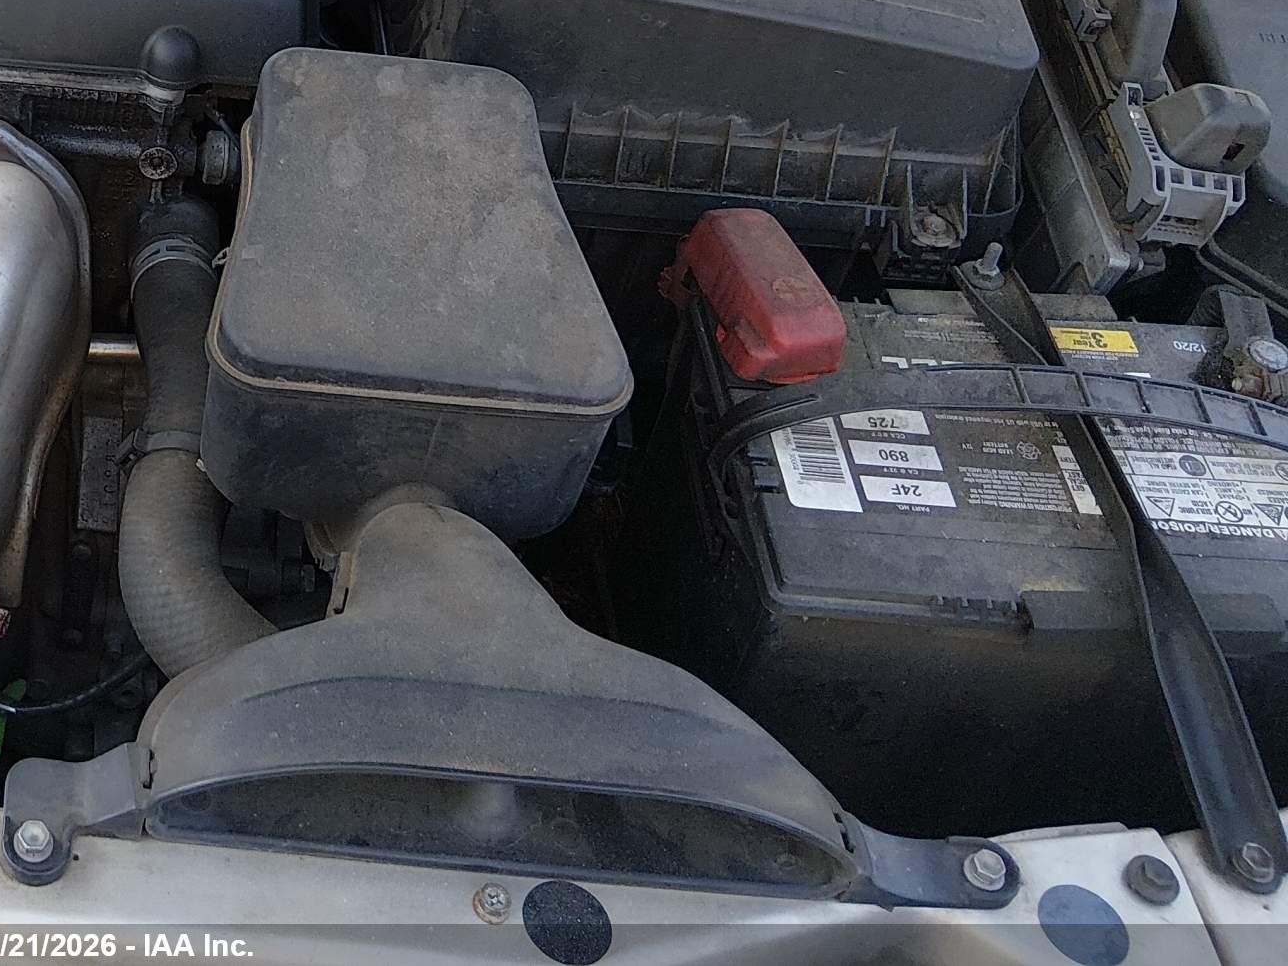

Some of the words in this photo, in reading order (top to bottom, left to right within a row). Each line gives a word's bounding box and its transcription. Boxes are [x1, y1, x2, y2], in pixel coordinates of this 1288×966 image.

[1173, 340, 1208, 354] 12/20
[867, 417, 900, 430] 725
[878, 449, 910, 463] 890
[891, 483, 922, 497] 24F
